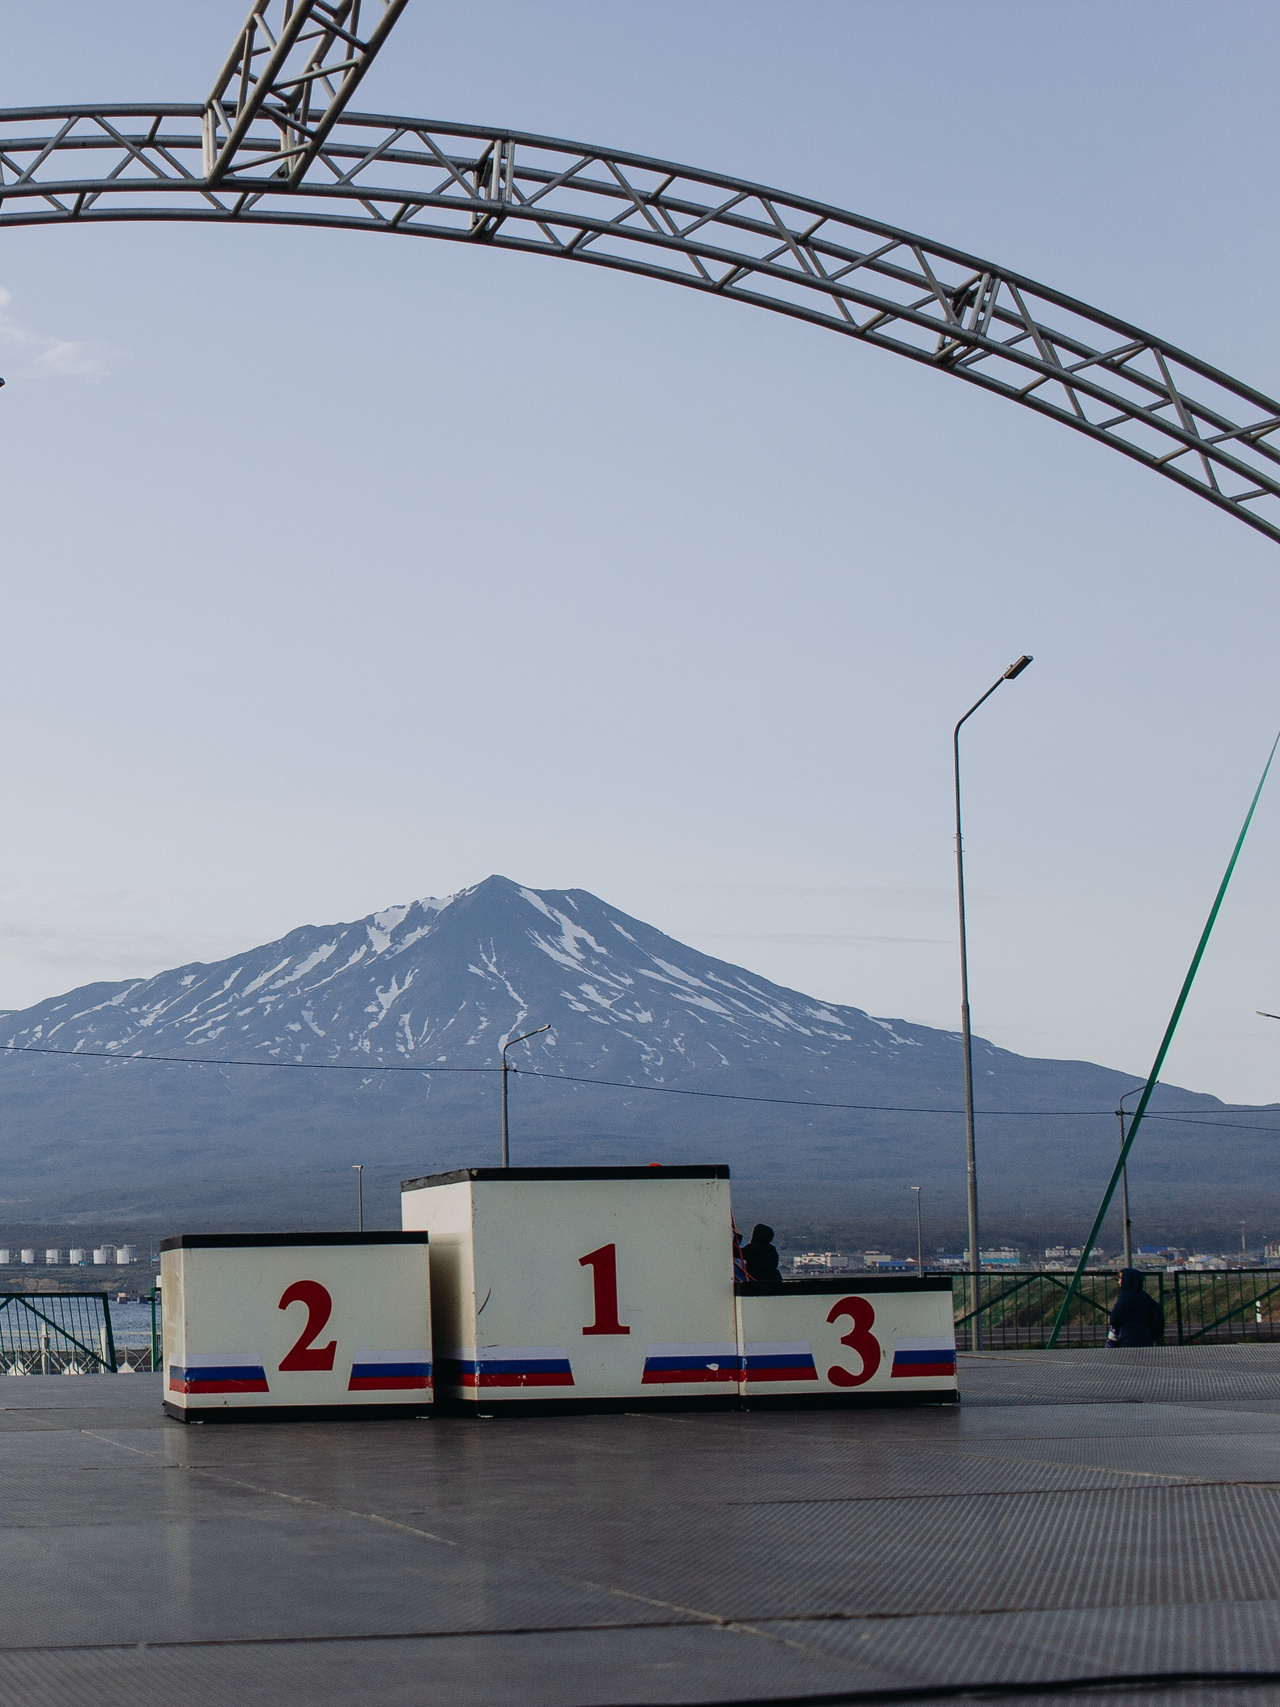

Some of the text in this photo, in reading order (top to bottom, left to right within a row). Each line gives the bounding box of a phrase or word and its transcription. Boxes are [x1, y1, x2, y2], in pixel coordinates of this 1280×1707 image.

[278, 1280, 337, 1371] 2
[578, 1243, 631, 1336] 1
[827, 1296, 880, 1387] 3
